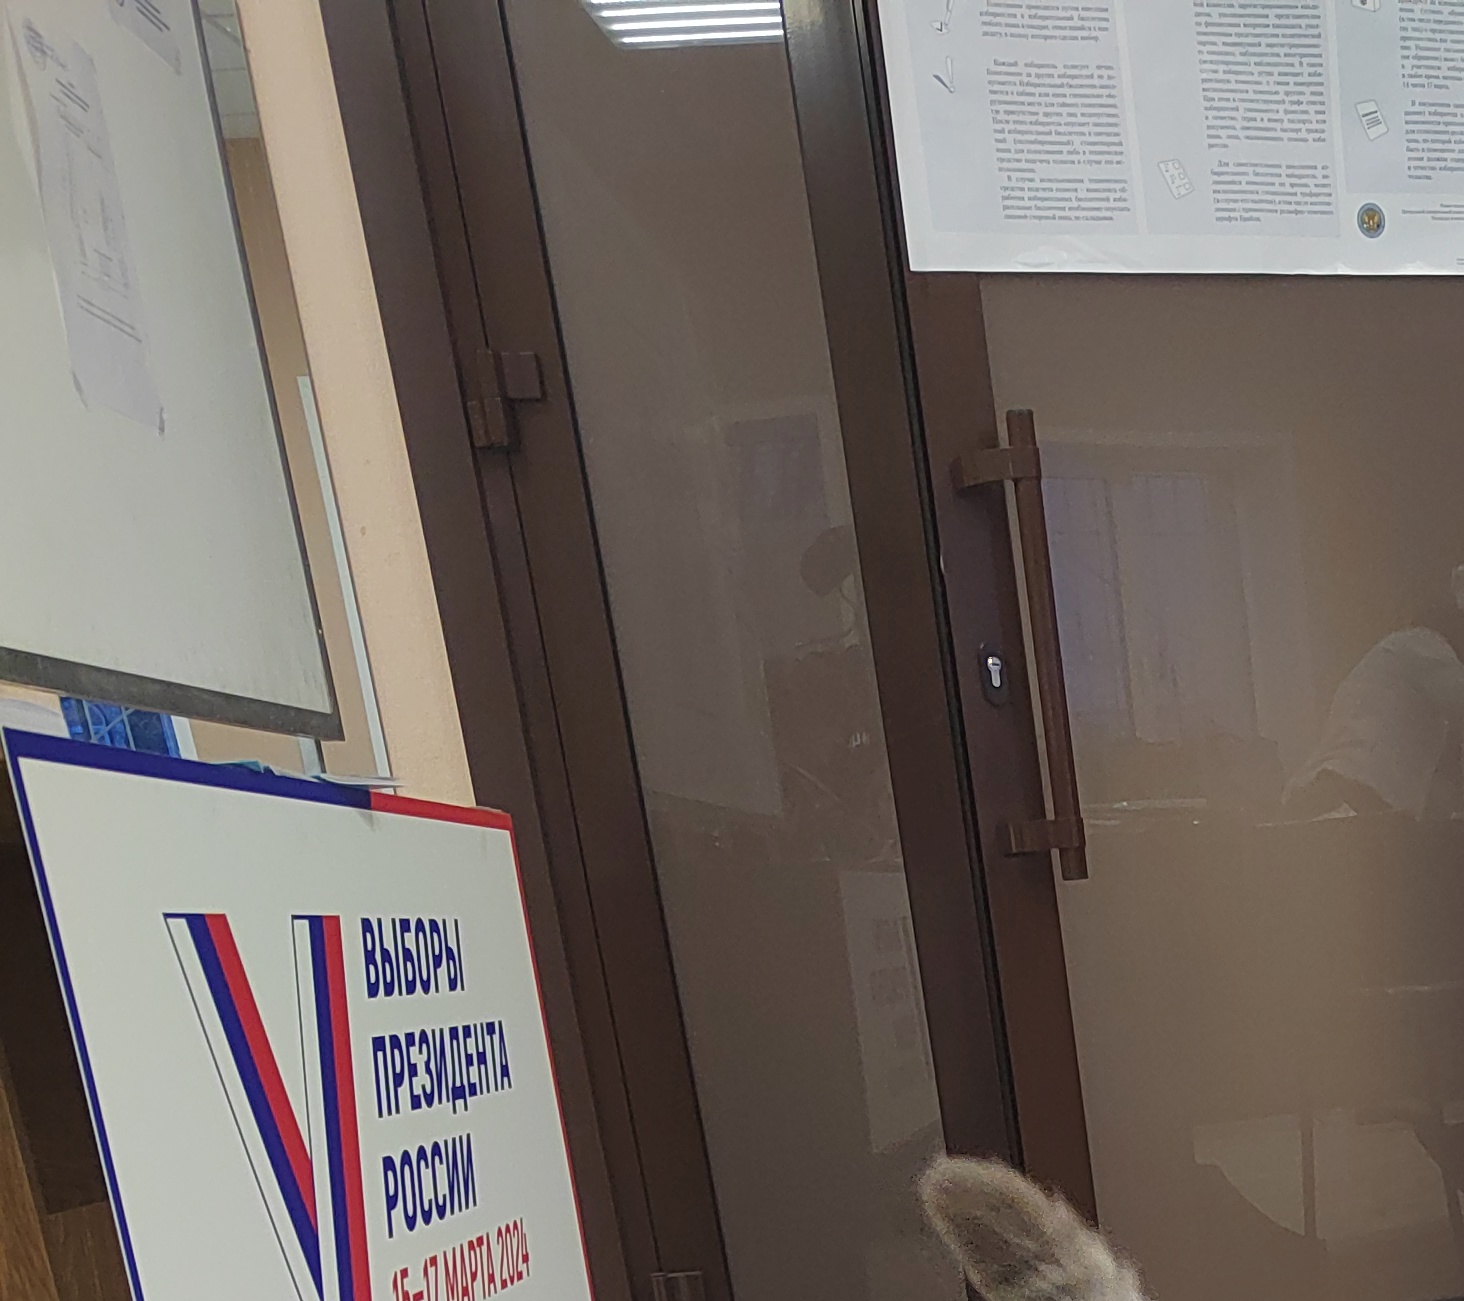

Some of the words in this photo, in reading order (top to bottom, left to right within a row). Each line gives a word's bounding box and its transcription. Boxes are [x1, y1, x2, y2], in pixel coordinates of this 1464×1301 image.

[361, 917, 465, 999] ВЫБОРЫ
[371, 1019, 512, 1118] ПРЕЗИДЕНТА
[382, 1132, 477, 1239] РОССИИ
[497, 1216, 530, 1290] 2024
